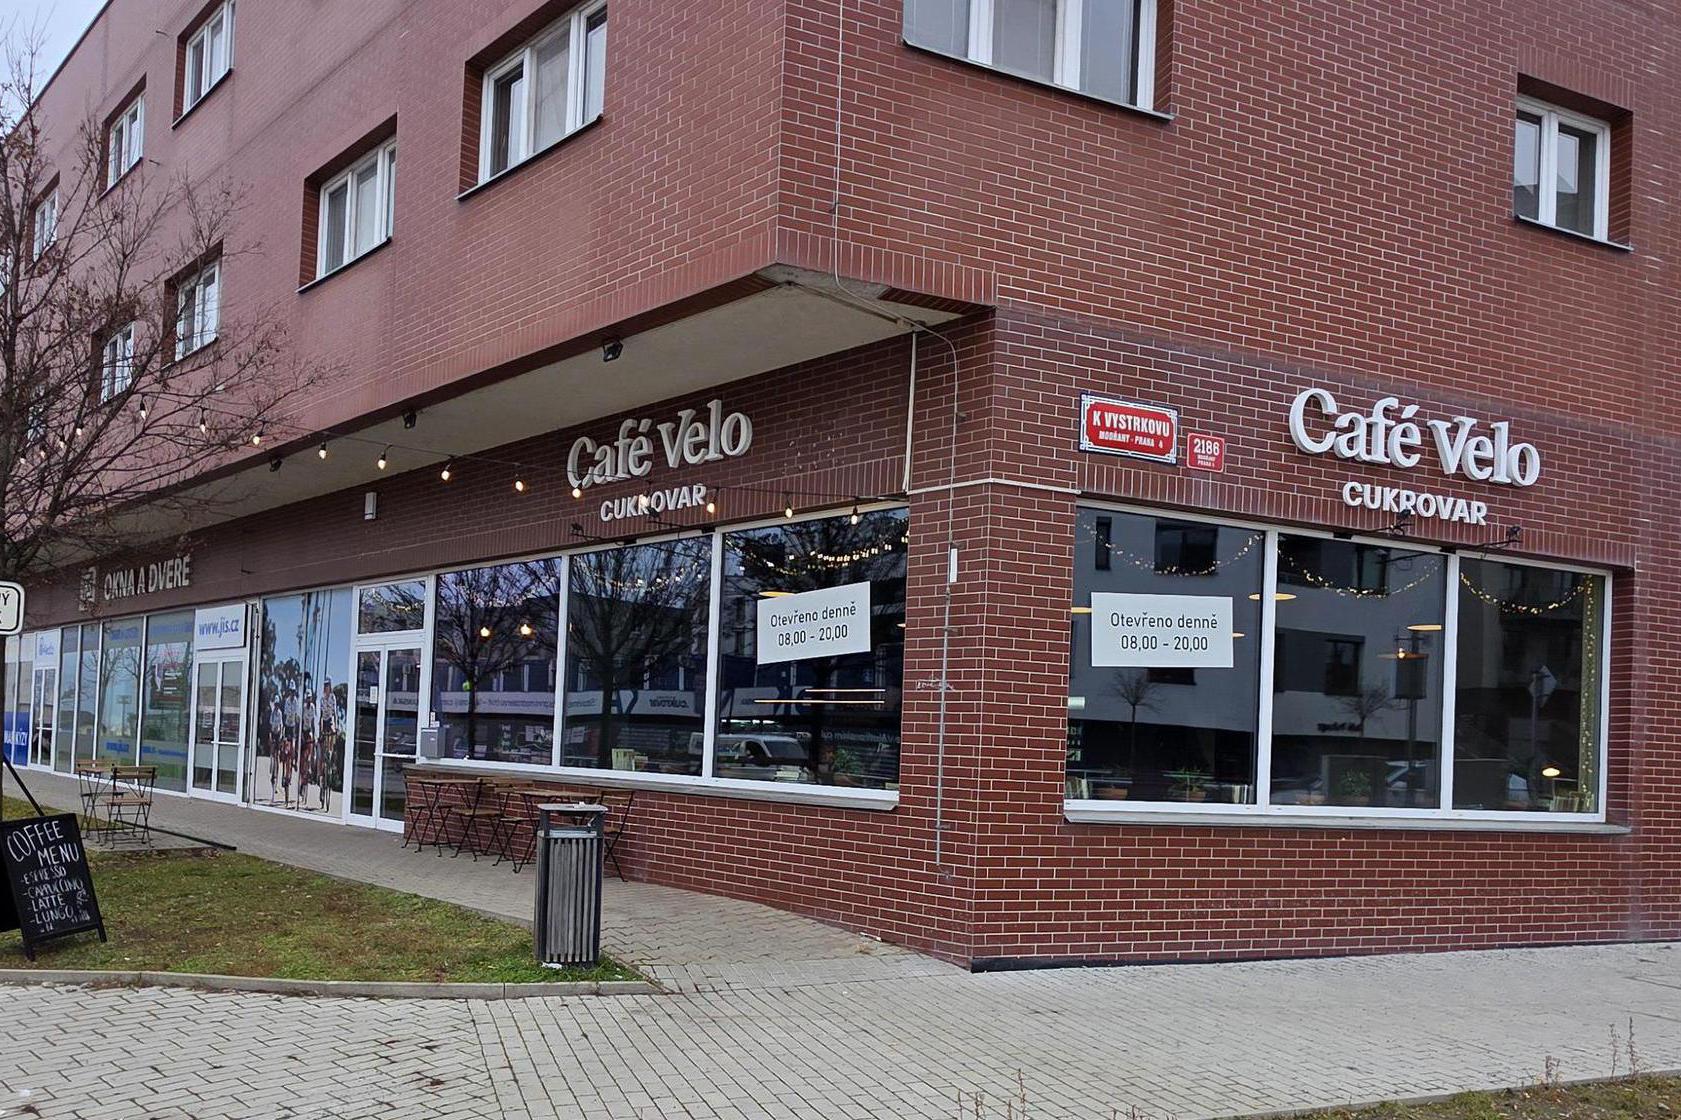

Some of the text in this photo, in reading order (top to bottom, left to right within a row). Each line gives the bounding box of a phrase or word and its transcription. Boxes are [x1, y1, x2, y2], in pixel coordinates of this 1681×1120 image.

[1093, 410, 1170, 438] K VYSTRKOVU
[567, 399, 753, 489] Café Velo
[1134, 435, 1155, 447] PRAHA
[1193, 437, 1220, 456] 2186
[1289, 388, 1541, 487] Café Velo
[600, 483, 707, 522] CUKROVAR
[1342, 481, 1488, 526] CUKROVAR
[104, 568, 135, 601] OKNA
[137, 566, 146, 595] A
[771, 601, 856, 628] Otevřeno denně
[1110, 611, 1218, 629] Otevřeno denně
[778, 629, 806, 647] 08,00
[819, 624, 848, 641] 20,00
[1121, 635, 1157, 651] 08,00
[1174, 636, 1208, 652] 20,00
[7, 820, 64, 863] COFFEE
[37, 842, 80, 867] MENU
[32, 893, 66, 912] LATTE
[35, 905, 74, 925] LUNGO
